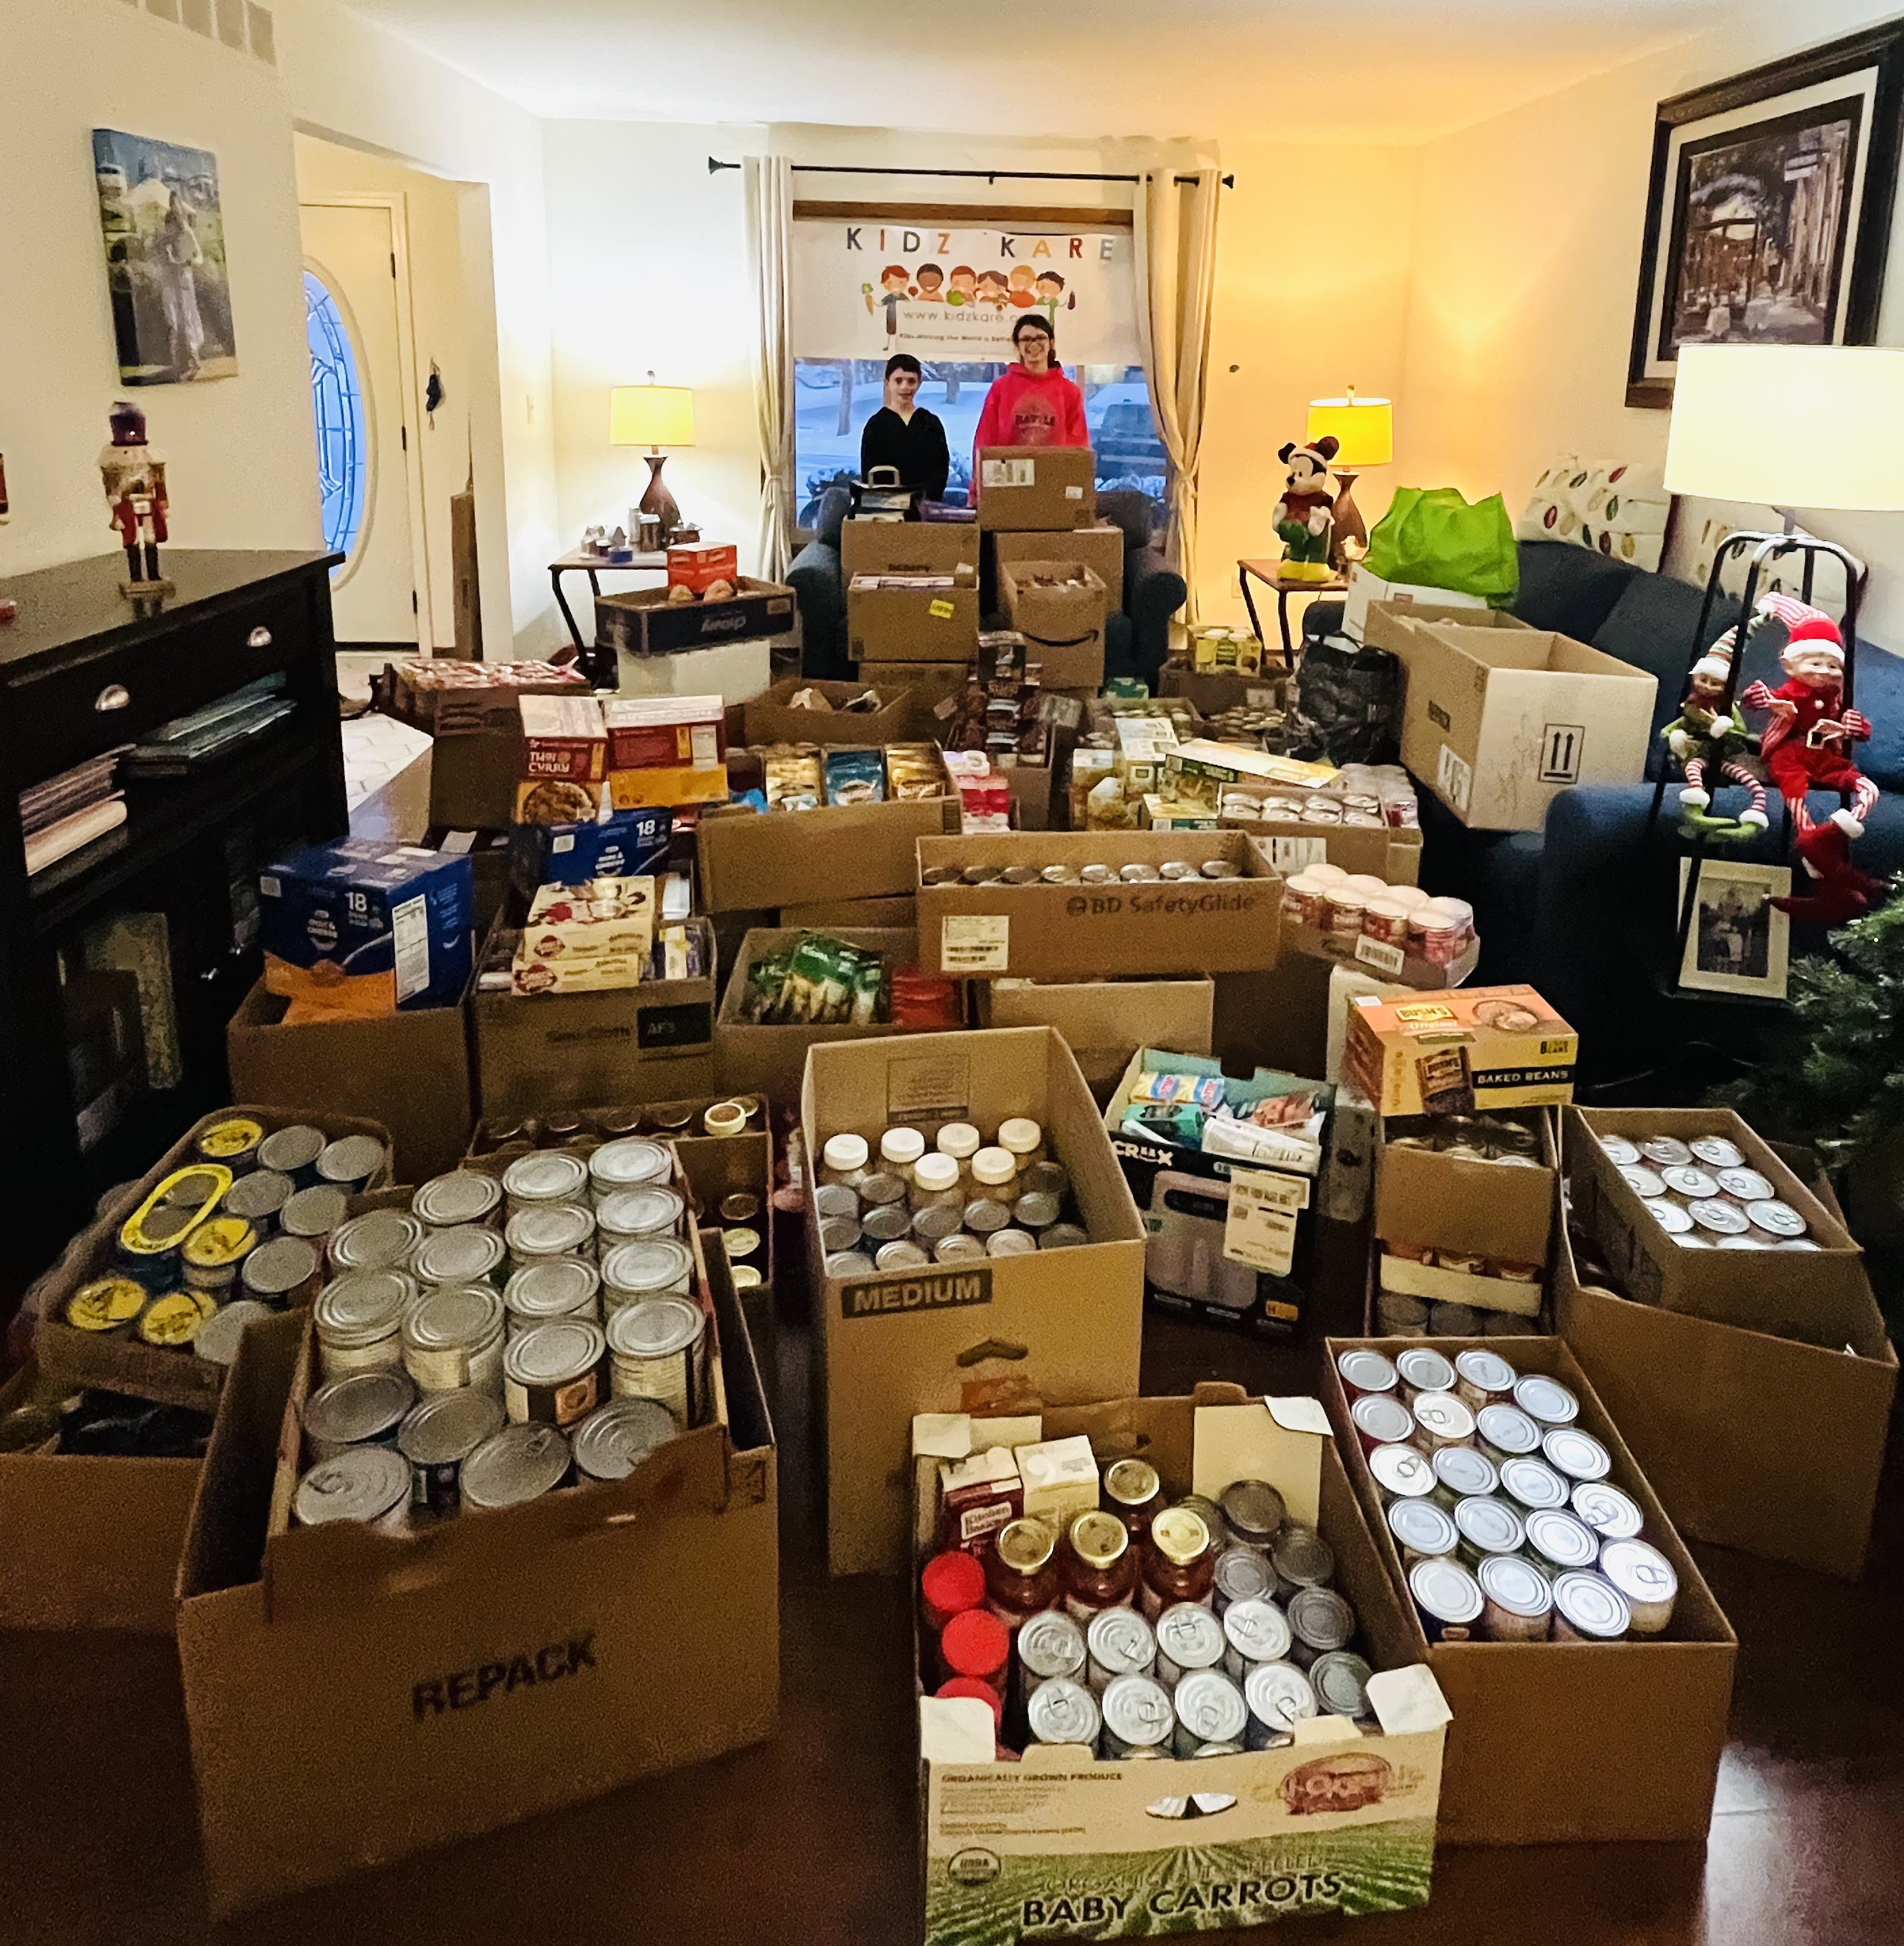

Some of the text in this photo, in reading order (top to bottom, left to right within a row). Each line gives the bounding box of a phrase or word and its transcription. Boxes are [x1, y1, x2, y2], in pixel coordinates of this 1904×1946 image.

[847, 227, 1114, 261] KIDZ KARE
[636, 820, 656, 837] 18
[344, 891, 367, 912] 18
[1091, 893, 1254, 914] BD SafetyGlide
[1477, 1071, 1569, 1084] BAKED BEANS
[853, 1276, 981, 1312] MEDIUM
[412, 1629, 596, 1725] REPACK
[942, 1775, 1021, 1783] ORGANICALLY
[1070, 1773, 1122, 1781] PRODUCE
[1023, 1874, 1341, 1926] BABY CARROTS
